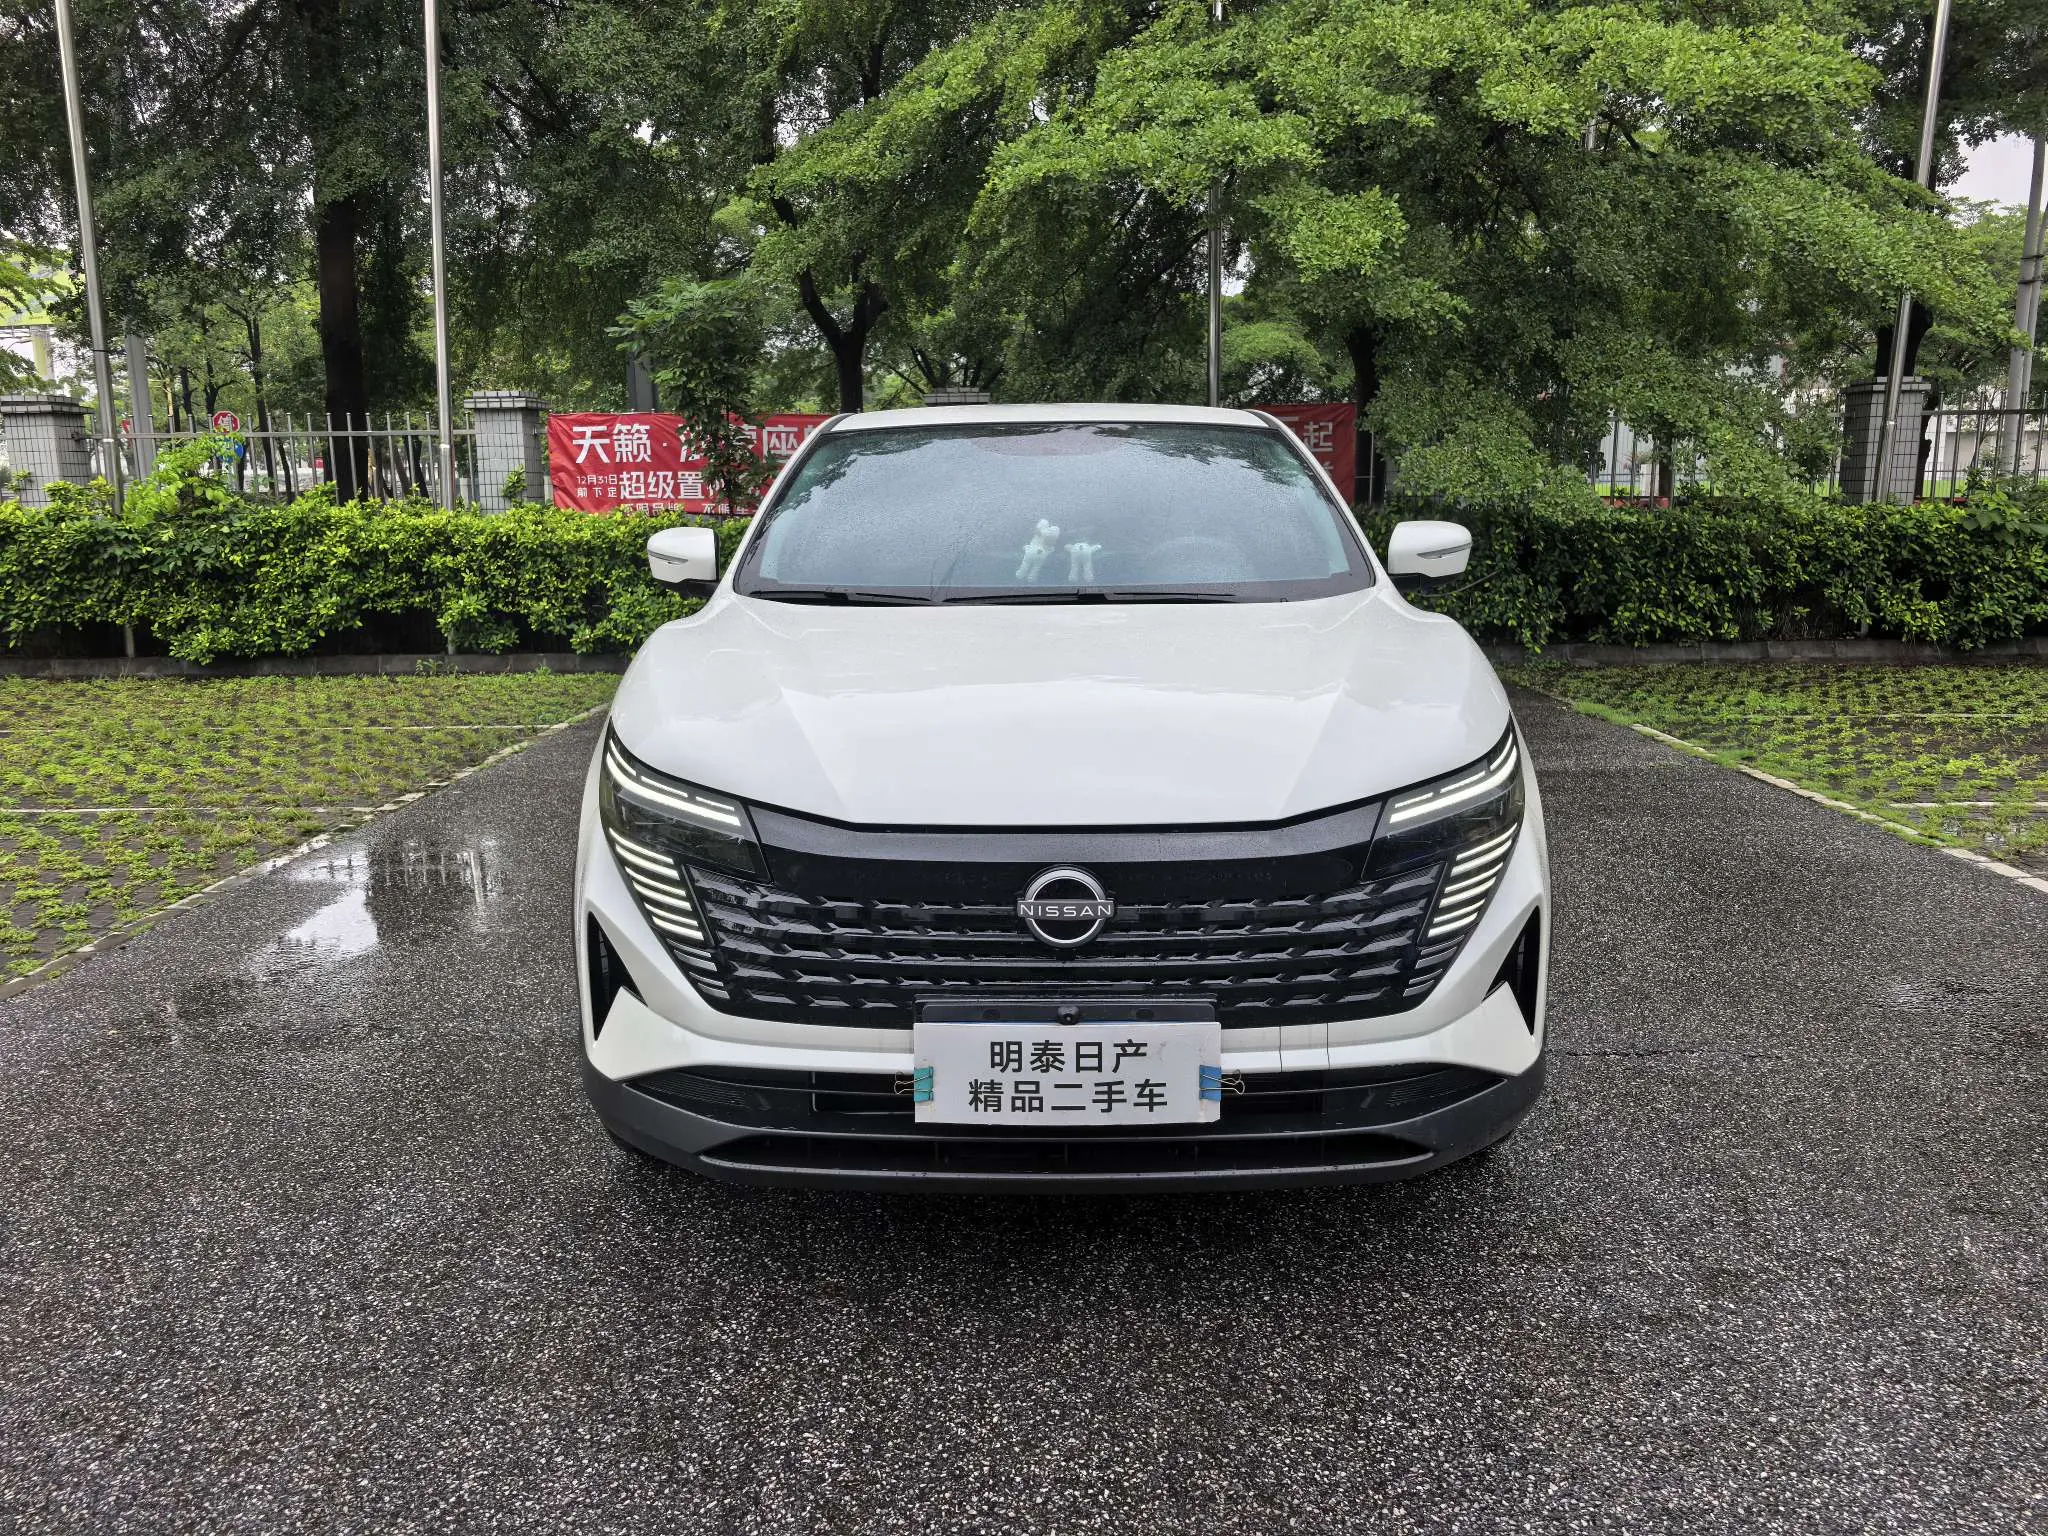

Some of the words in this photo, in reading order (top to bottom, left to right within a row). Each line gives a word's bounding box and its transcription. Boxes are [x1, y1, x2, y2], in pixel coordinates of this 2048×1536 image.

[576, 474, 618, 485] 12月31日
[1020, 904, 1112, 918] NISSAN
[989, 1039, 1149, 1074] 明泰日产
[968, 1078, 1168, 1113] 精品二手车
